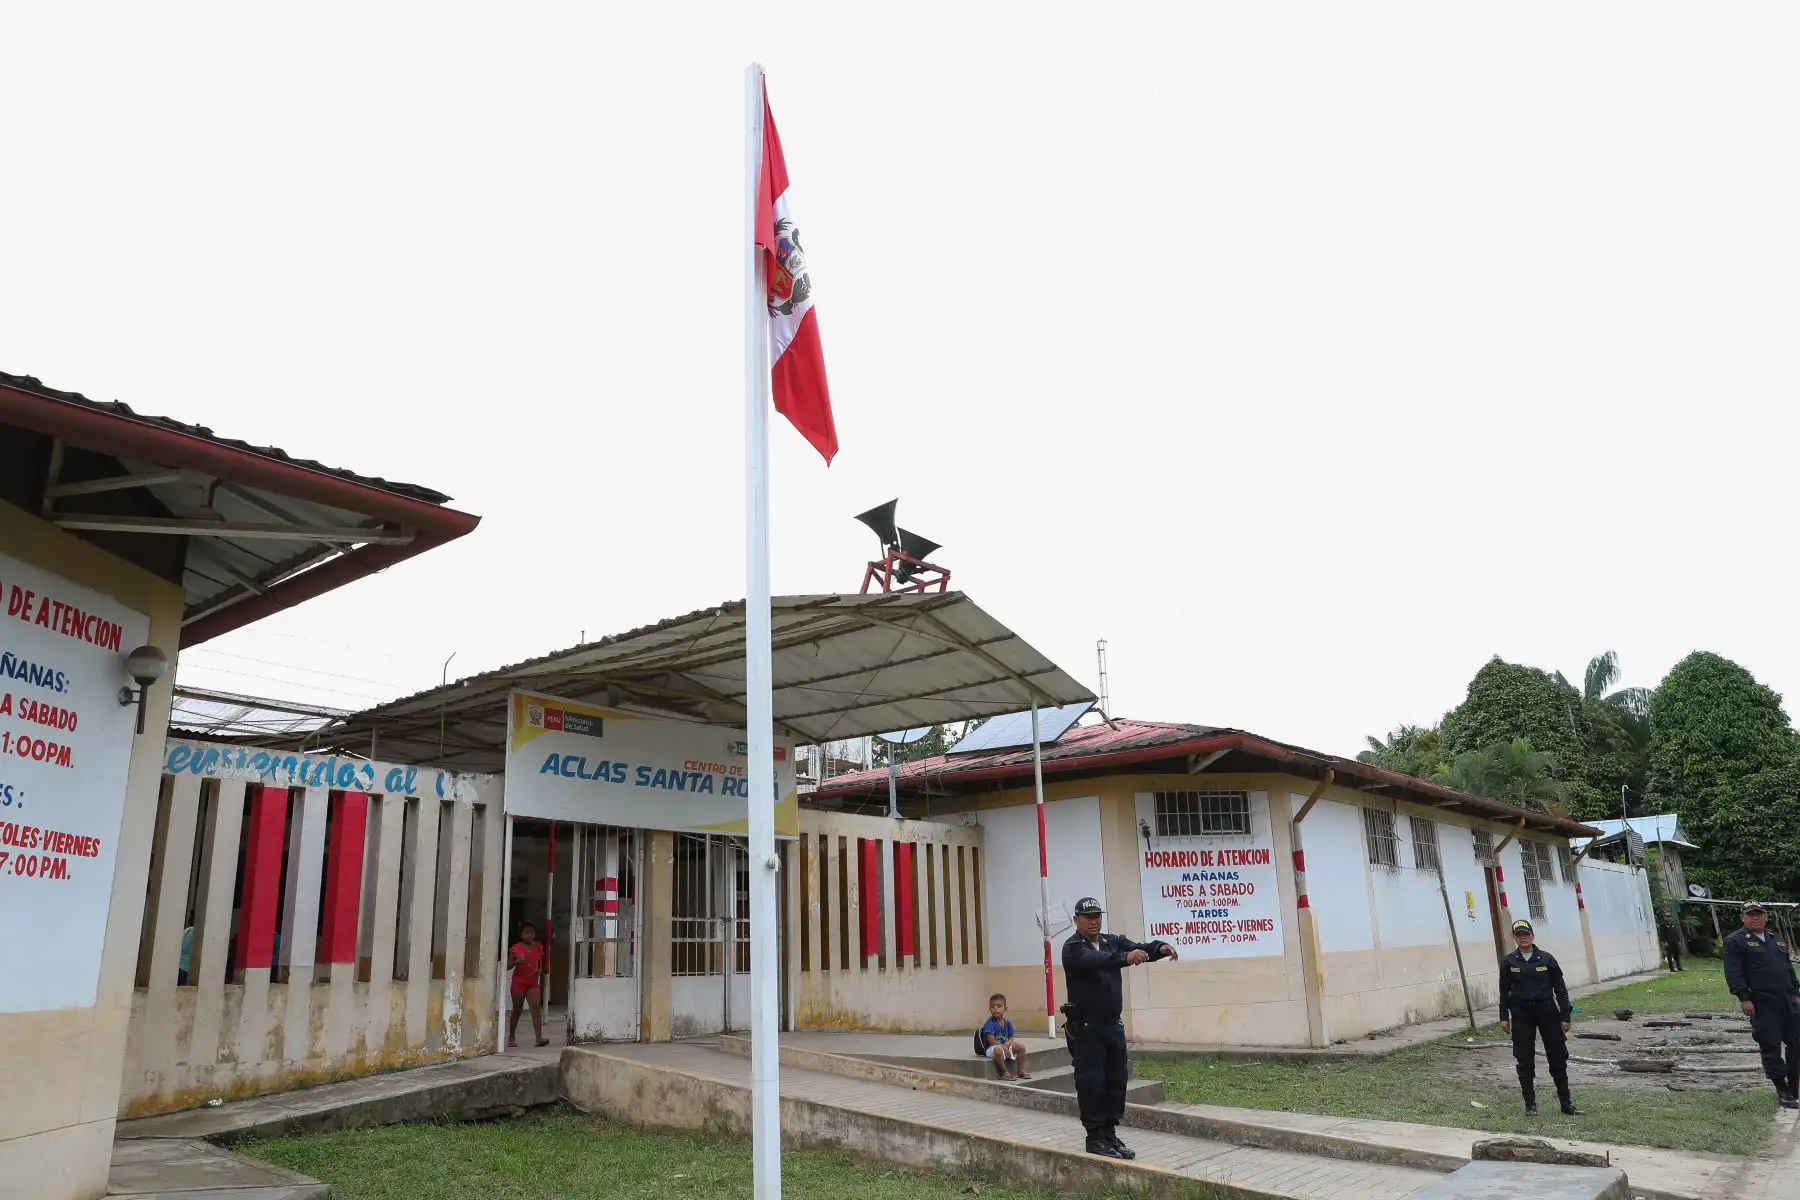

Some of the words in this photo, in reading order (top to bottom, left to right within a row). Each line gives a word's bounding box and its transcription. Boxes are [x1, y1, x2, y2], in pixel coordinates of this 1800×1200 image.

[8, 585, 35, 622] DE
[35, 597, 122, 653] ATENCION
[0, 693, 12, 716] A
[18, 697, 78, 732] SABADO
[565, 714, 594, 726] Ministerio
[564, 722, 574, 730] de
[574, 723, 589, 732] Salud
[540, 752, 629, 784] ACLAS
[635, 765, 714, 794] SANTA
[721, 776, 780, 801] RO
[684, 760, 727, 776] CENTRO
[729, 765, 744, 778] DE
[385, 766, 418, 795] al
[1145, 850, 1198, 868] HORARIO
[1201, 850, 1214, 866] DE
[1217, 849, 1270, 866] ATENCION
[1182, 870, 1240, 882] MAÑANAS
[1161, 884, 1194, 898] LUNES
[1199, 884, 1207, 897] A
[1210, 882, 1254, 896] SABADO
[1191, 908, 1229, 919] TARDES
